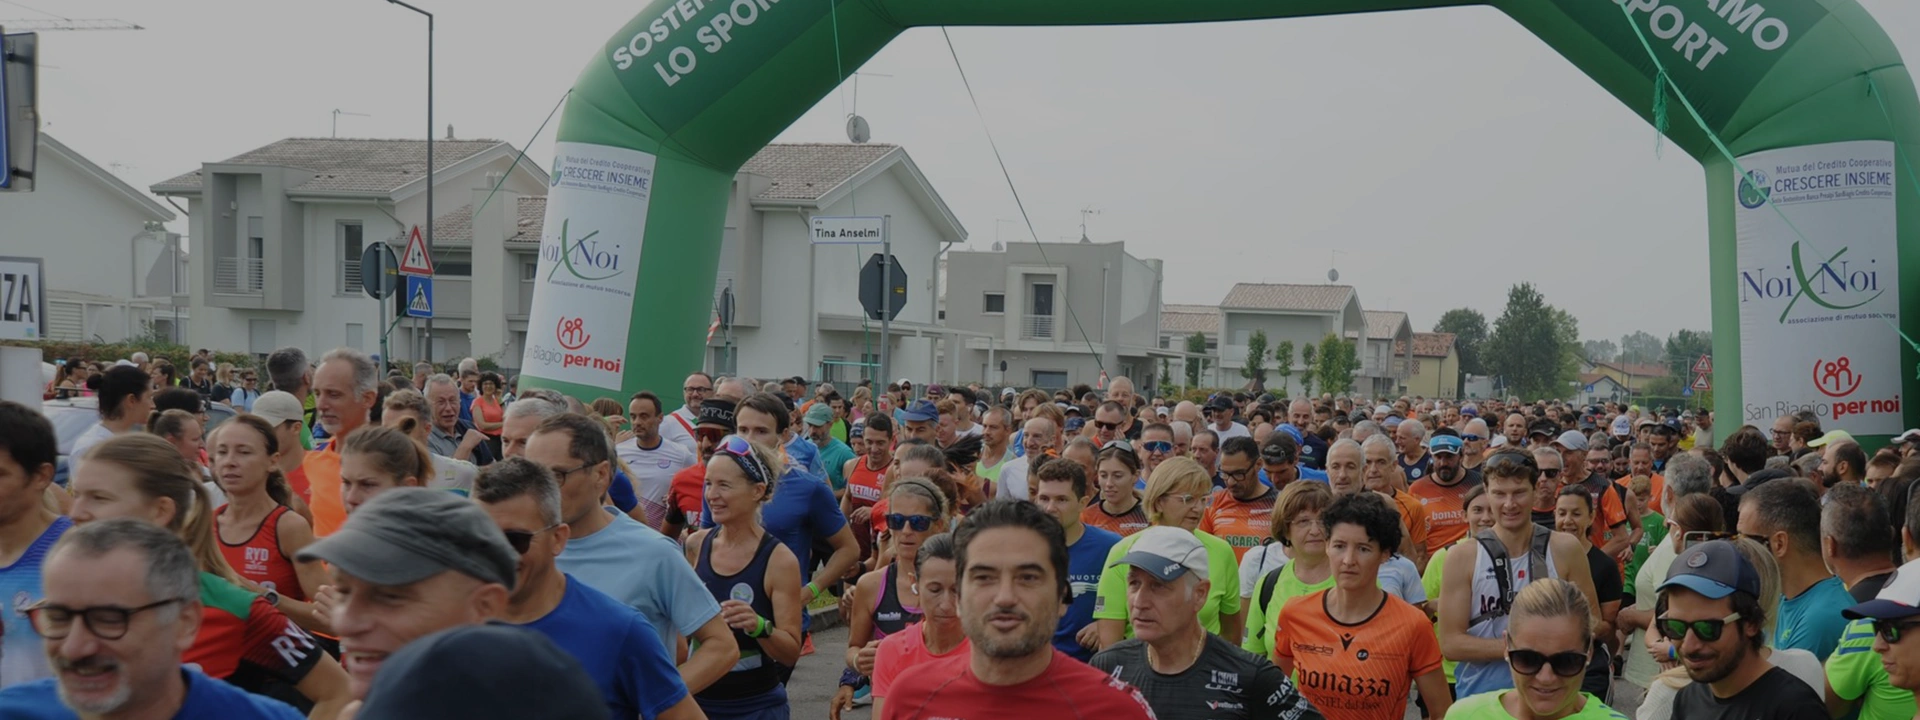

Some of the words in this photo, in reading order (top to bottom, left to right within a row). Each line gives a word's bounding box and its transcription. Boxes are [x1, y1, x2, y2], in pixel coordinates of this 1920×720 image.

[1612, 0, 1729, 71] PORT
[653, 46, 696, 87] LO
[589, 159, 610, 167] Credito
[612, 161, 651, 175] Cooperativo
[1776, 165, 1800, 174] Mutua
[1803, 163, 1815, 172] del
[1817, 161, 1846, 170] Credito
[1849, 158, 1892, 168] Cooperativo
[563, 166, 605, 182] CRESCERE
[606, 171, 649, 190] INSIEME
[1774, 174, 1841, 193] CRESCERE
[1845, 172, 1892, 186] INSIEME
[815, 228, 836, 238] Tina
[839, 228, 880, 238] Anselmi
[573, 239, 620, 270] Noi
[1741, 265, 1792, 302] Noi
[1818, 259, 1879, 294] Noi
[0, 273, 35, 322] ZA
[1788, 312, 1834, 324] associazione
[1835, 312, 1843, 321] di
[1844, 312, 1867, 321] mutuo
[563, 353, 591, 368] per
[593, 357, 621, 373] noi
[1745, 402, 1772, 421] San
[1833, 400, 1867, 420] per
[1871, 395, 1900, 413] noi
[245, 546, 269, 561] RYD
